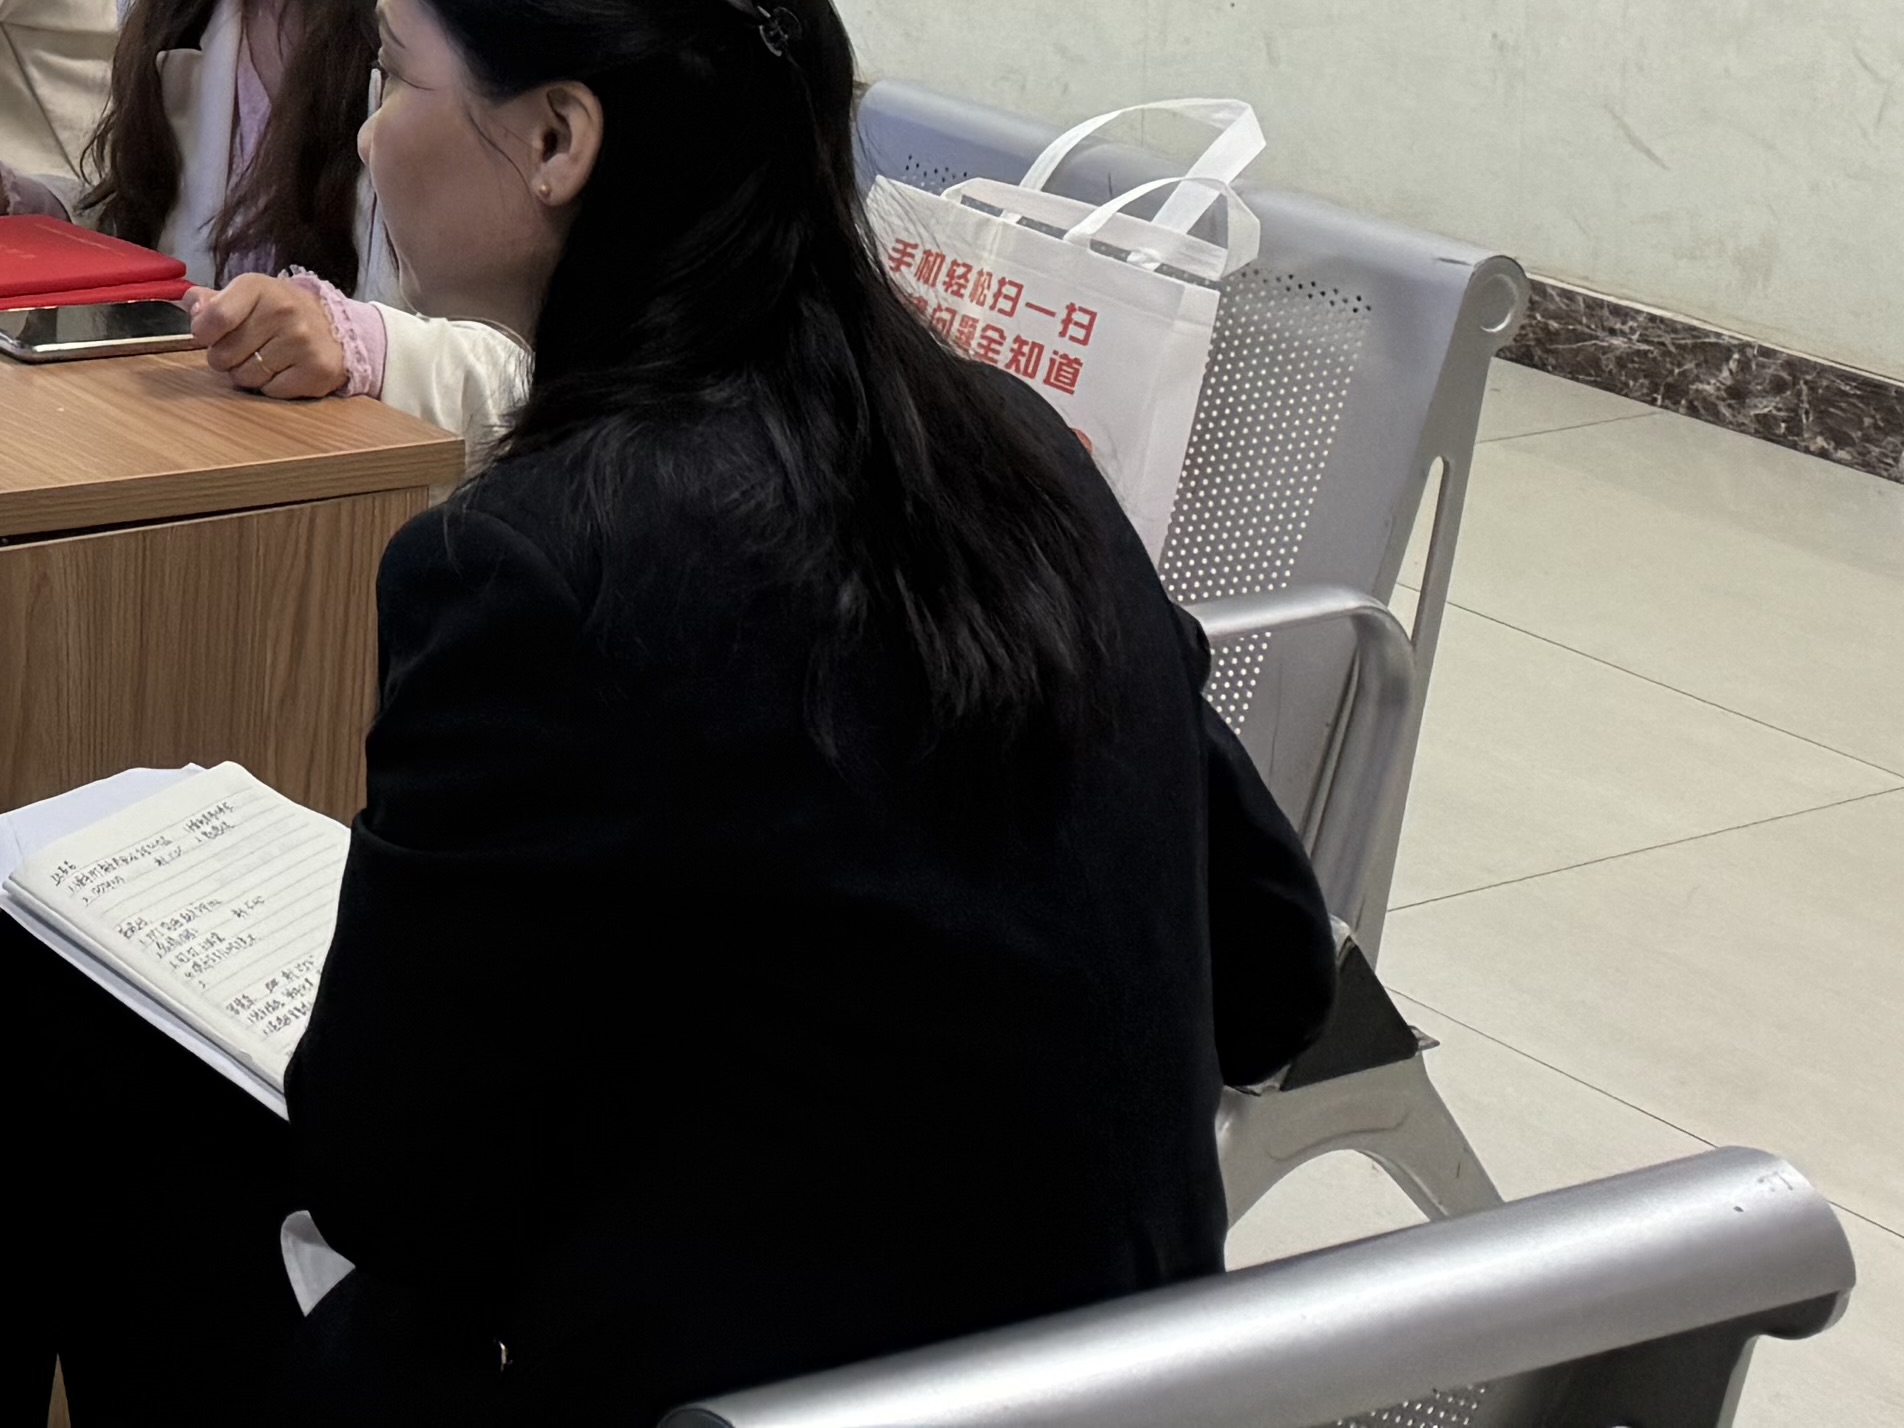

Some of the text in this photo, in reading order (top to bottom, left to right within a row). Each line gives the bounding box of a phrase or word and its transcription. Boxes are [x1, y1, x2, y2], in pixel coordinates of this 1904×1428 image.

[888, 238, 1098, 347] 手机轻松扫一扫
